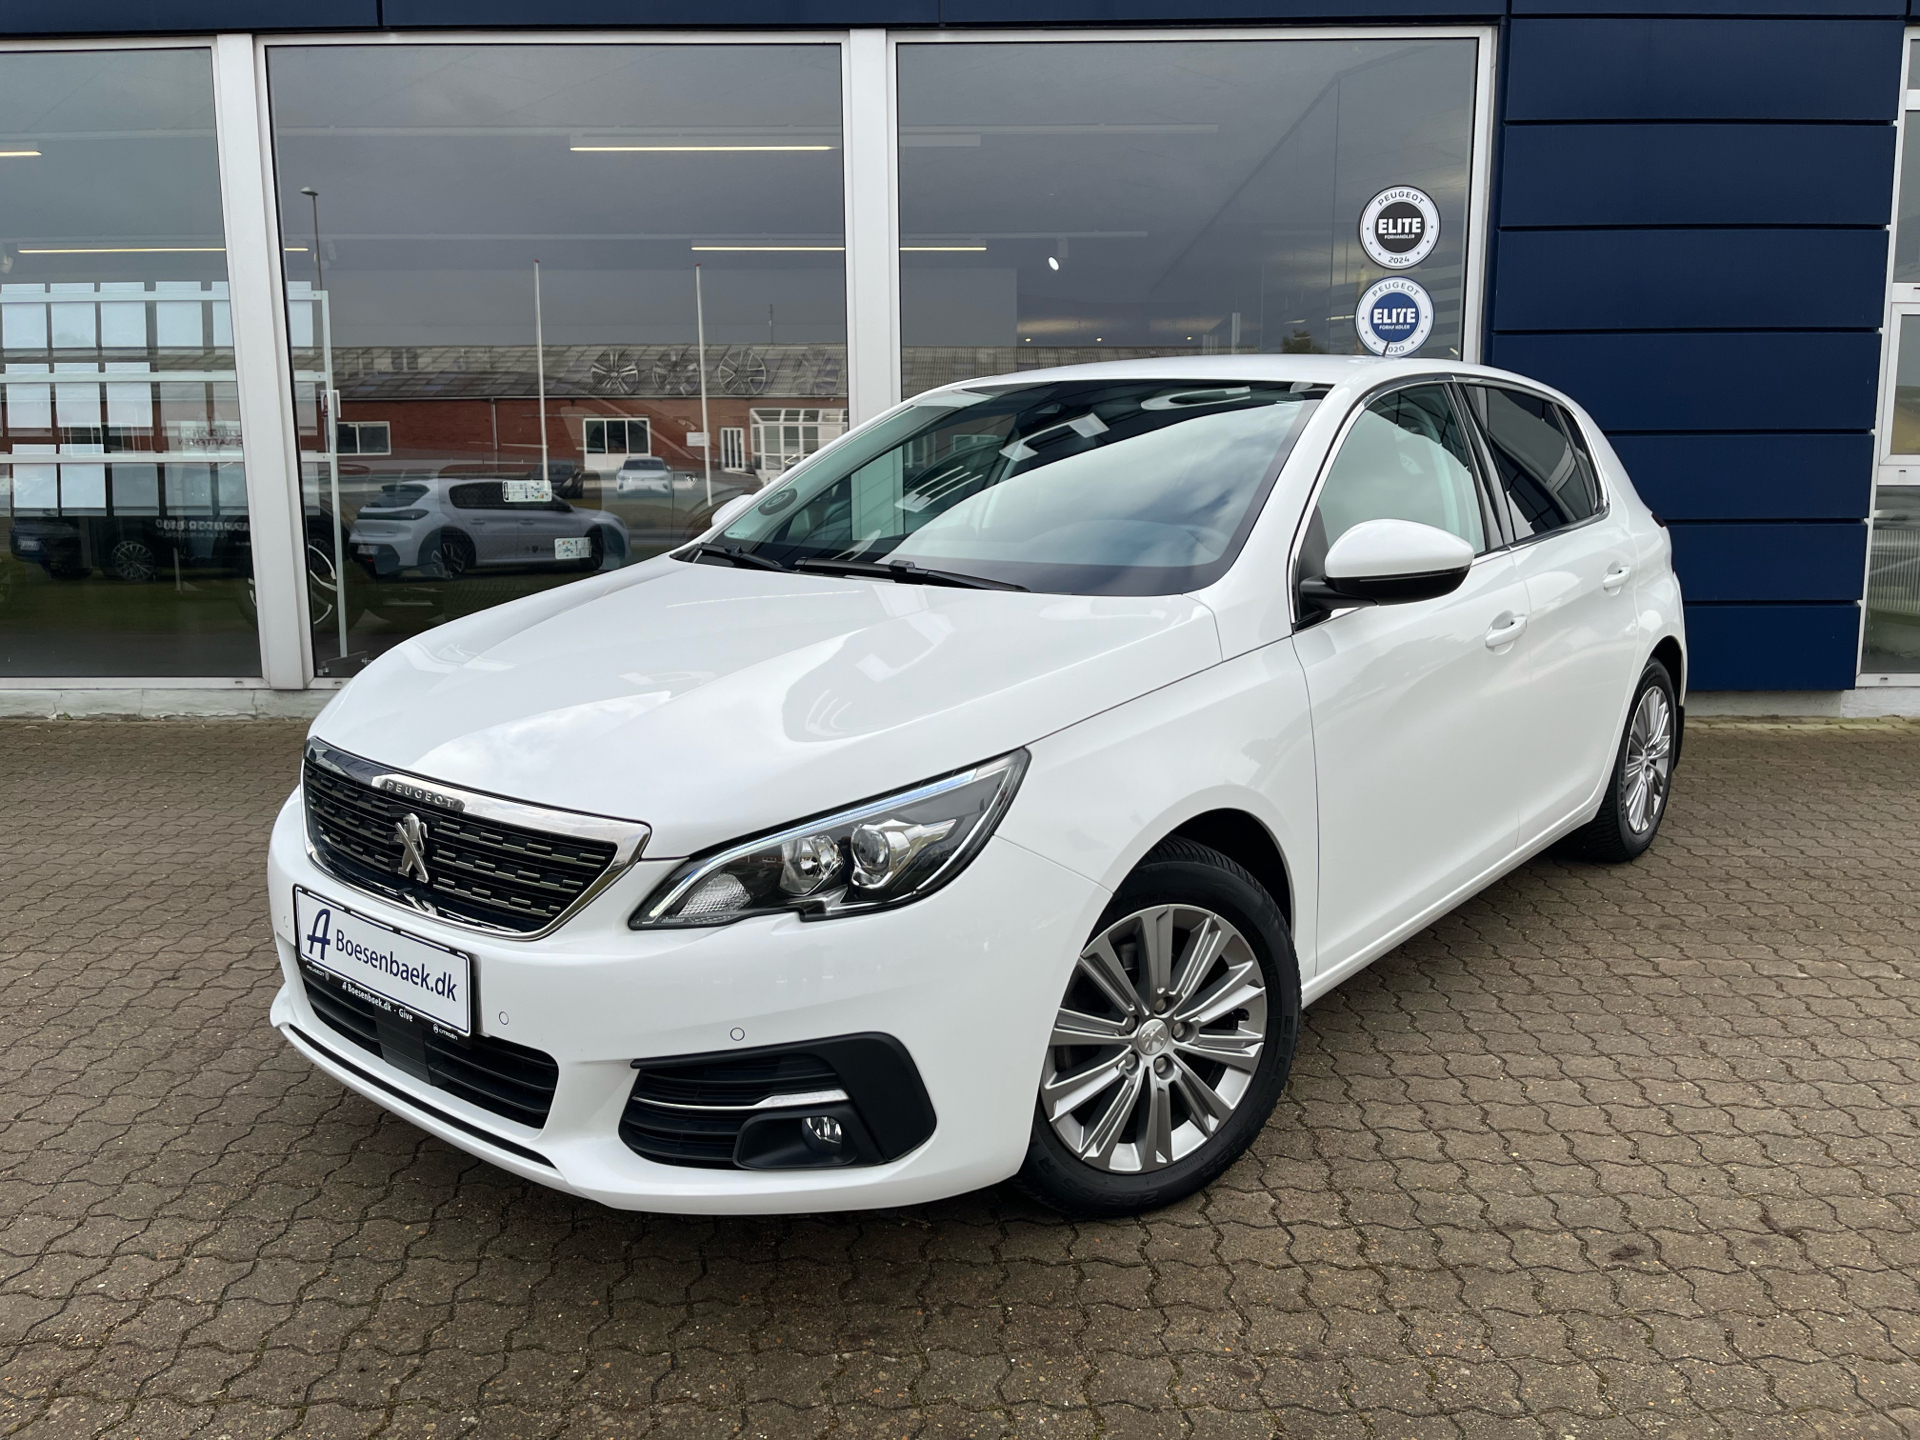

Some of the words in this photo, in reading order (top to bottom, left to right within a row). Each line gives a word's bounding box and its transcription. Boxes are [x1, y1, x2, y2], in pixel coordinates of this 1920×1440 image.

[1378, 191, 1425, 207] PEUGEOT
[1378, 217, 1422, 234] ELITE
[1388, 256, 1410, 264] 2024
[1372, 281, 1420, 297] PEUGEOT
[1373, 308, 1416, 324] ELITE
[1384, 345, 1405, 353] 020
[386, 780, 453, 808] PEUGEOT
[336, 929, 458, 1002] Boesenbaek.dk
[348, 983, 392, 1012] Boesenbaek.dk
[398, 1008, 413, 1022] Give
